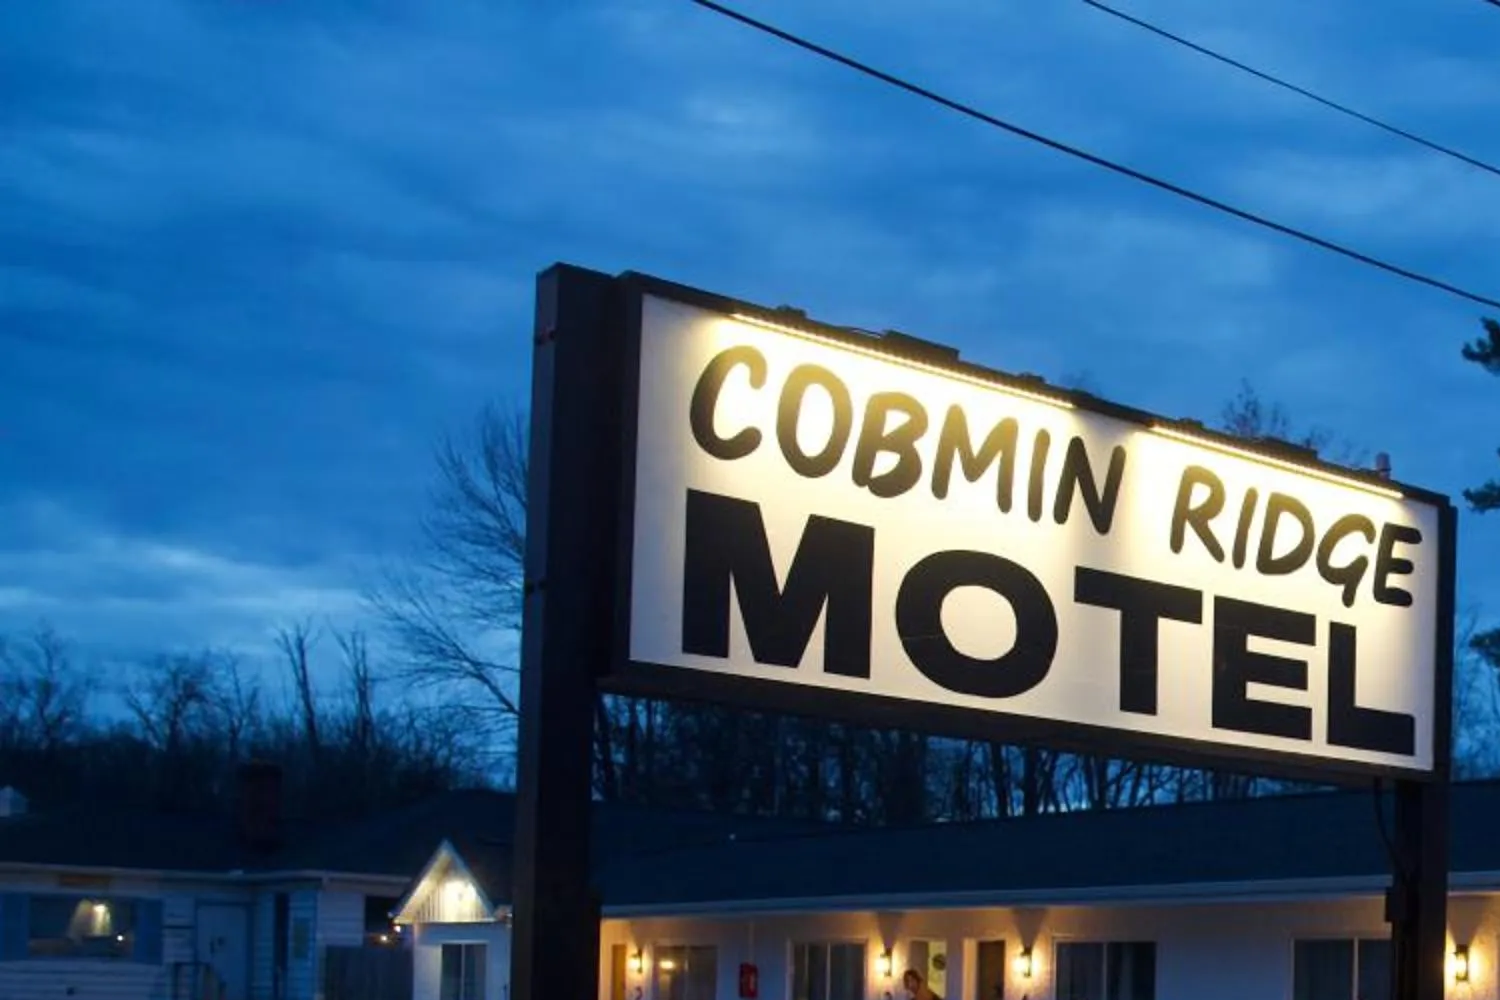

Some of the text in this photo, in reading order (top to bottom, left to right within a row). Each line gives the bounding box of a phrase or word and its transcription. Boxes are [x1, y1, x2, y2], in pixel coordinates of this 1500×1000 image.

[690, 346, 1422, 608] COBMIN RIDGE
[682, 488, 1415, 756] MOTEL
